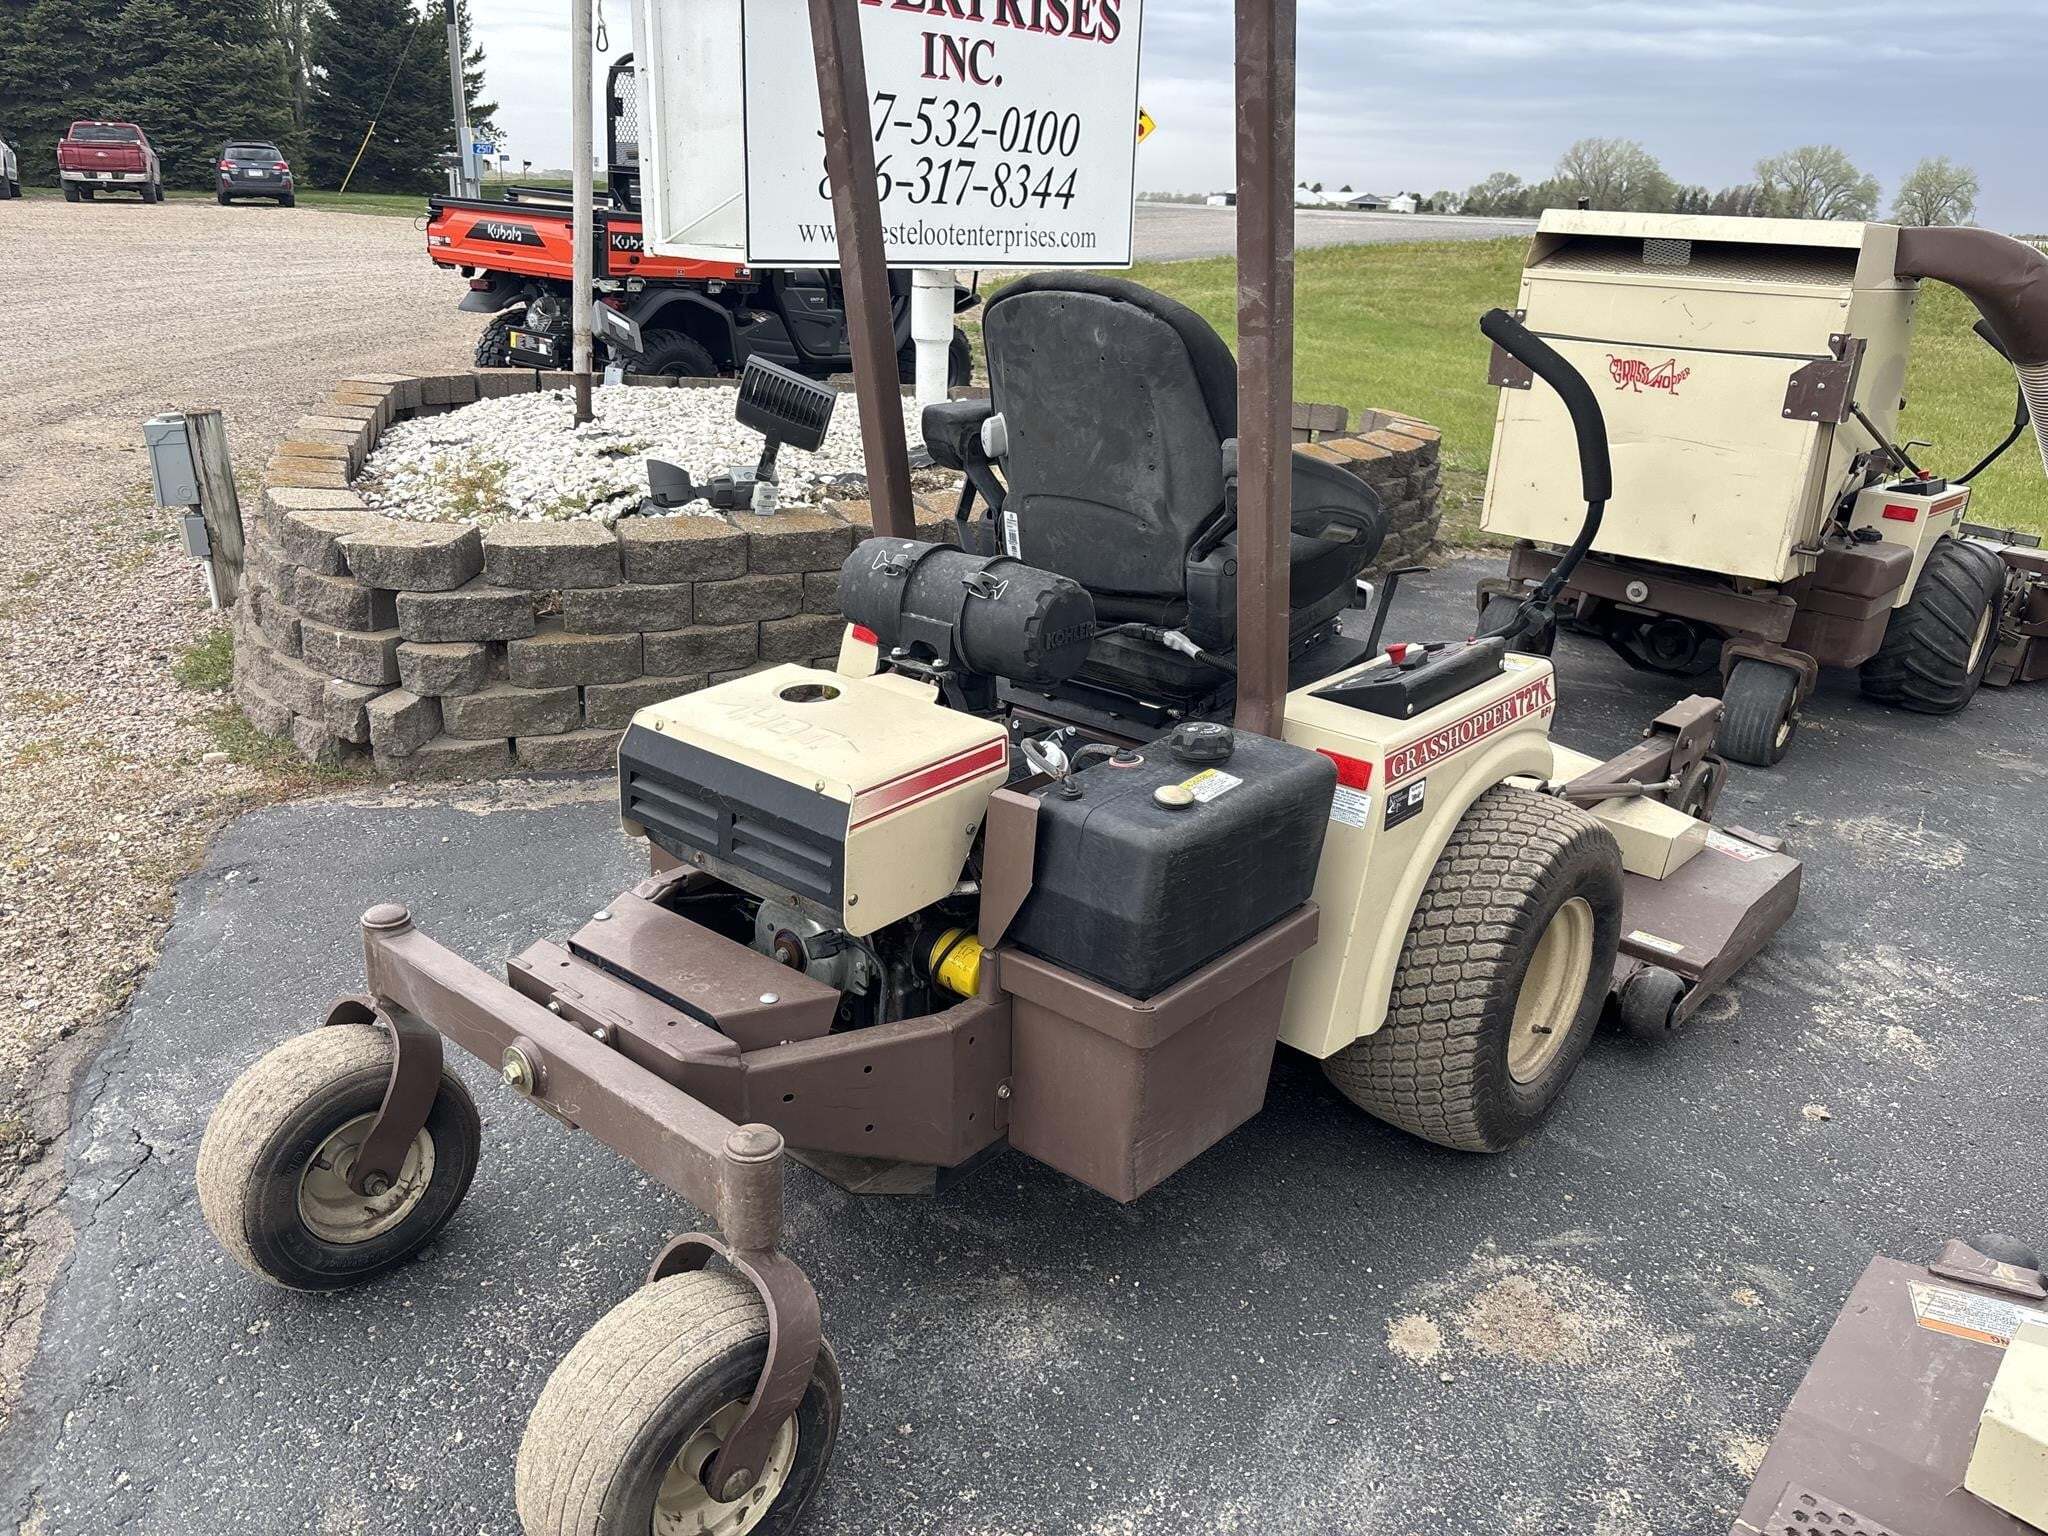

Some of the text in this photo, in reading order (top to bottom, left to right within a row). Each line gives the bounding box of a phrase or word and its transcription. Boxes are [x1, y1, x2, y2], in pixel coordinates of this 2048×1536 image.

[920, 31, 1003, 88] INC.
[817, 90, 1081, 157] 7-532-0100
[818, 154, 1078, 210] 6-317-8344
[487, 223, 522, 242] Kubota
[798, 219, 1097, 254] wwestelootenterprises.com
[1609, 356, 1691, 390] GRASSHOPPER
[1044, 621, 1095, 650] KOHLER
[1390, 677, 1552, 778] GRASSHOPPER 727K
